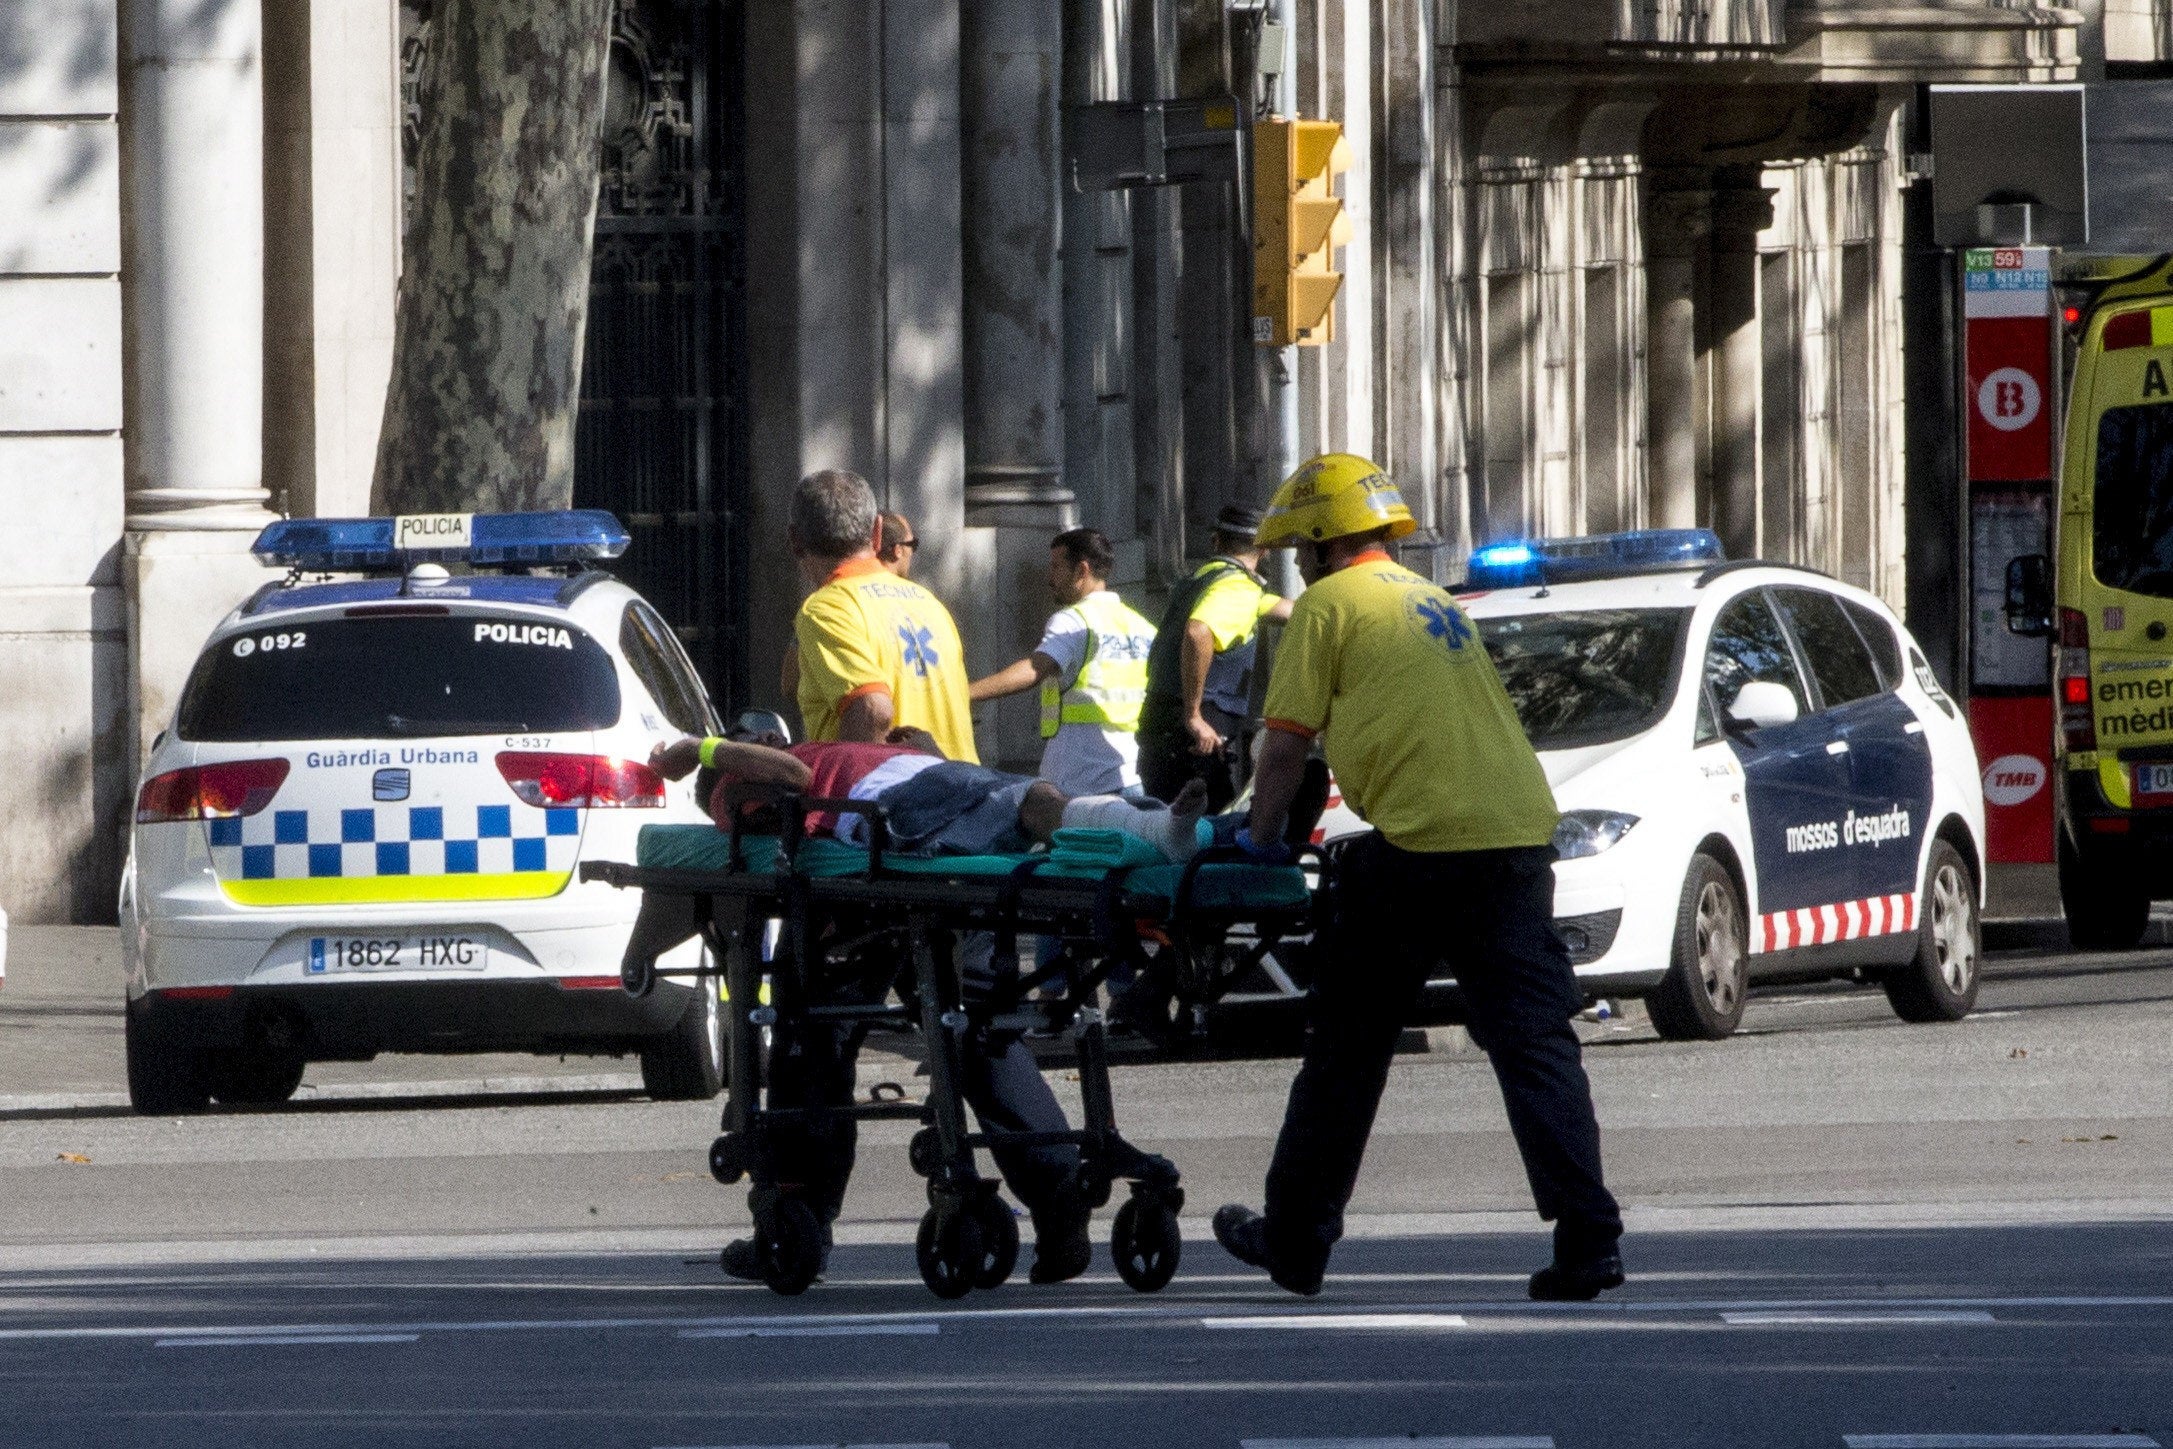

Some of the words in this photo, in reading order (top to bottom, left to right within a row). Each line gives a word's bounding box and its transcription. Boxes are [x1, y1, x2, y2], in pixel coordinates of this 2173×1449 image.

[1996, 381, 2024, 417] B
[402, 518, 463, 535] POLICIA
[260, 631, 306, 652] 092
[474, 623, 574, 650] POLICIA
[306, 751, 391, 769] Guàrdia
[401, 748, 478, 765] Urbana
[1995, 772, 2036, 788] TMB
[1786, 821, 1839, 853] mossos
[1843, 803, 1910, 848] d'esquadra
[335, 939, 401, 967] 1862
[420, 937, 474, 965] HXG
